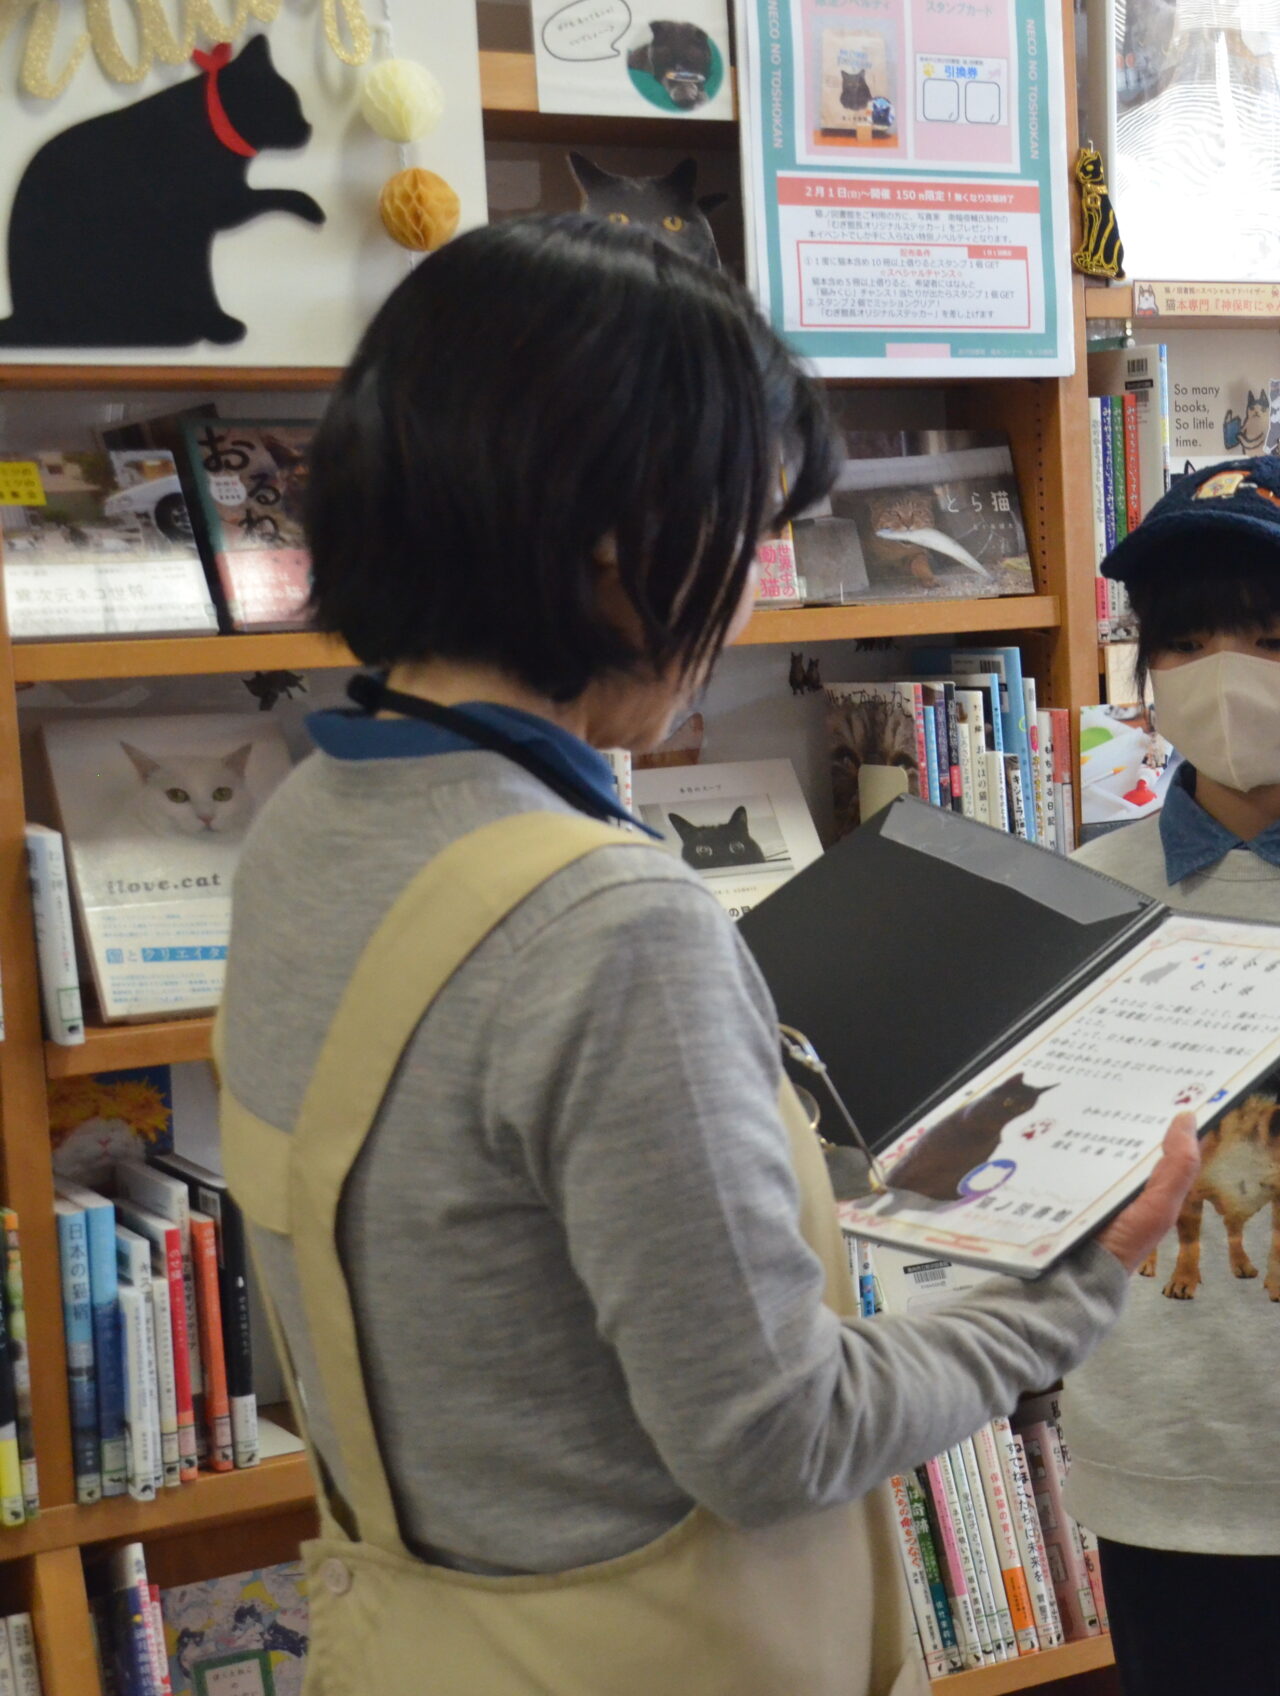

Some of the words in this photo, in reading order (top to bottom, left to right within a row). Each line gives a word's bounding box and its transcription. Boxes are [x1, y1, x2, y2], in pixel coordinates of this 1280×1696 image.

[927, 2, 993, 17] スタンプカード
[1026, 19, 1037, 56] NECO
[771, 44, 781, 65] NO
[944, 64, 978, 79] 引換券
[1028, 60, 1038, 80] NO
[771, 69, 783, 149] TOSHOKAN
[1029, 85, 1041, 160] TOSHOKAN
[1174, 384, 1189, 396] So
[1191, 386, 1220, 398] many
[1174, 401, 1210, 414] books,
[1175, 418, 1189, 430] So
[1192, 419, 1215, 430] little
[1175, 436, 1202, 447] time.
[946, 490, 1011, 513] とら猫
[777, 544, 796, 597] 世界中の
[107, 872, 222, 895] ilove.cat
[976, 1195, 1073, 1224] 猫ノ図書館
